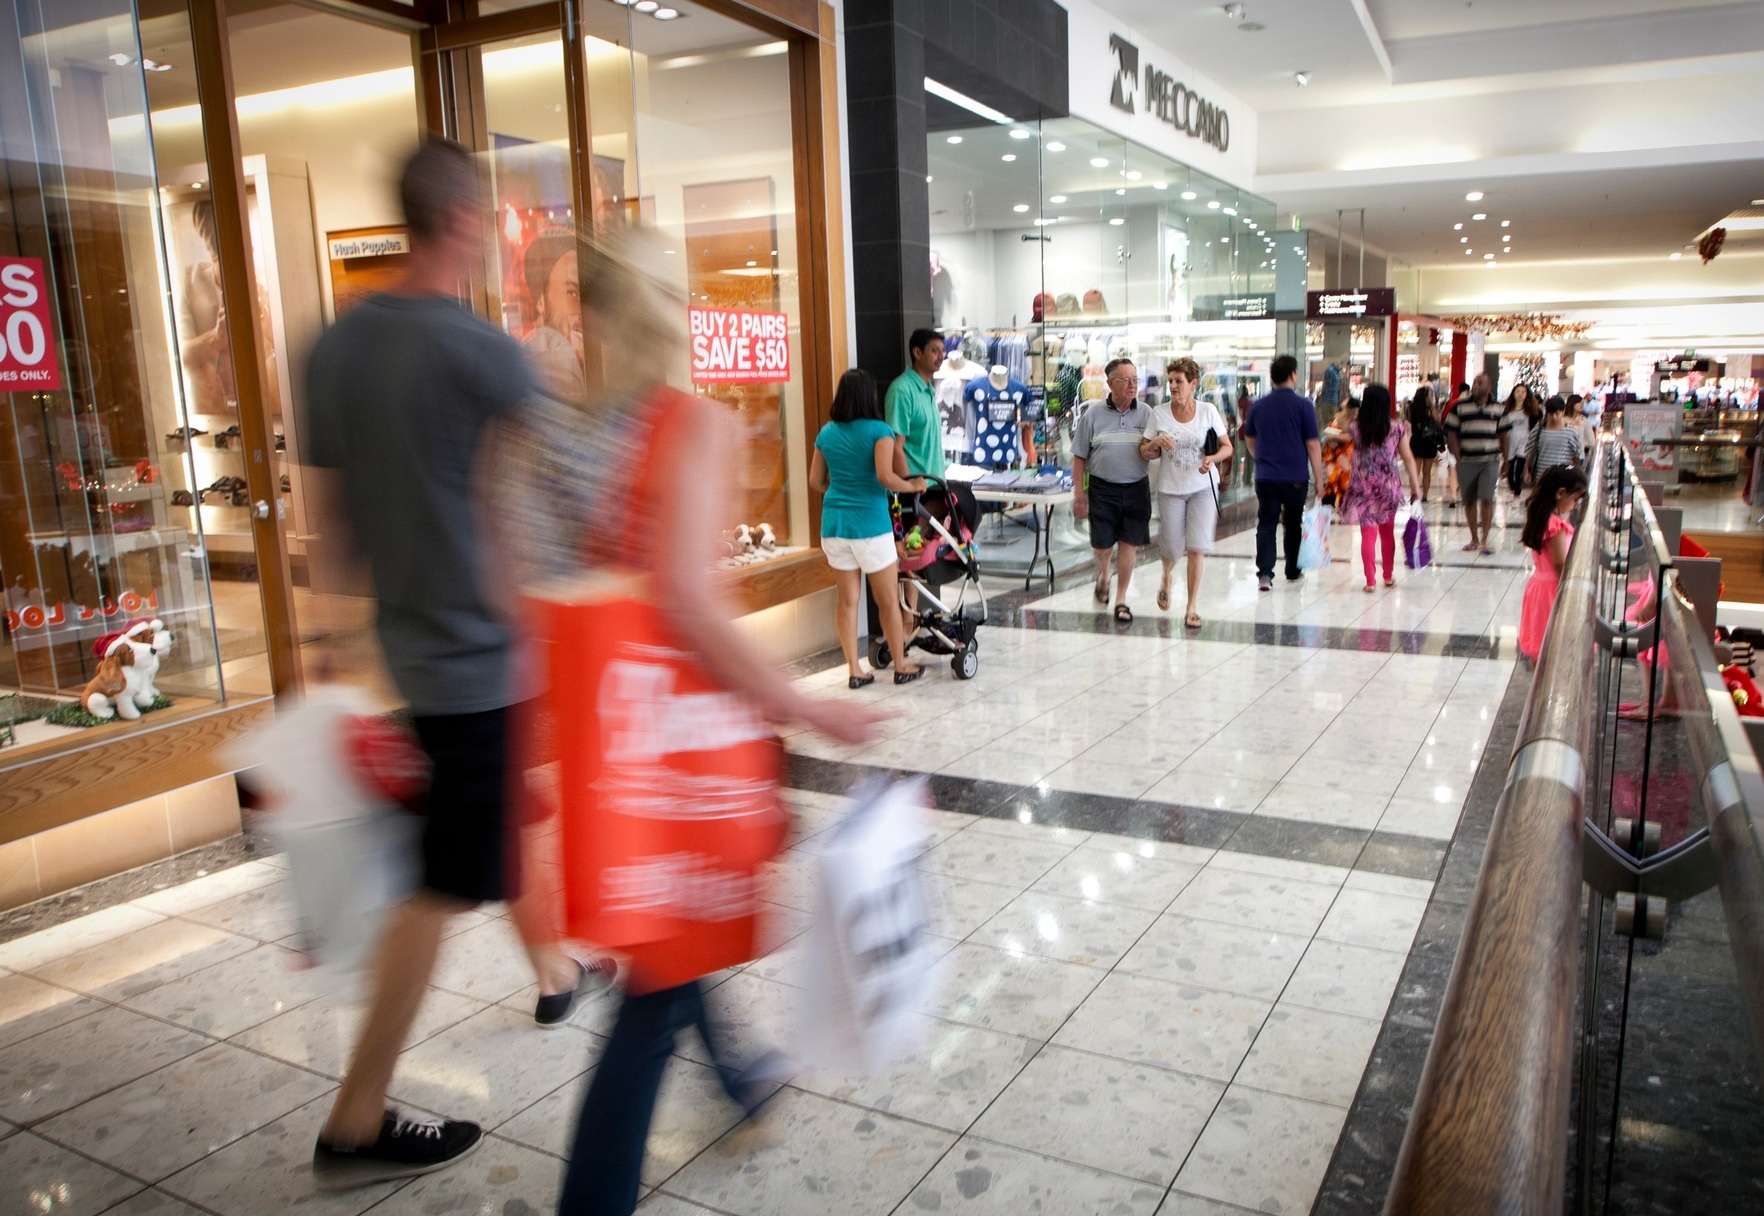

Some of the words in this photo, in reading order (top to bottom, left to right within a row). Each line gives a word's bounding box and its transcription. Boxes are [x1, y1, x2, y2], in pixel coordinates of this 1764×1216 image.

[1145, 61, 1230, 152] MECCANO
[333, 242, 360, 257] Hush
[361, 239, 402, 256] Puppies
[0, 263, 39, 308] S
[690, 310, 727, 337] BUY
[728, 313, 739, 338] 2
[741, 313, 787, 339] PAIRS
[693, 335, 752, 370] SAVE
[755, 337, 788, 372] $50
[20, 370, 52, 381] ONLY.
